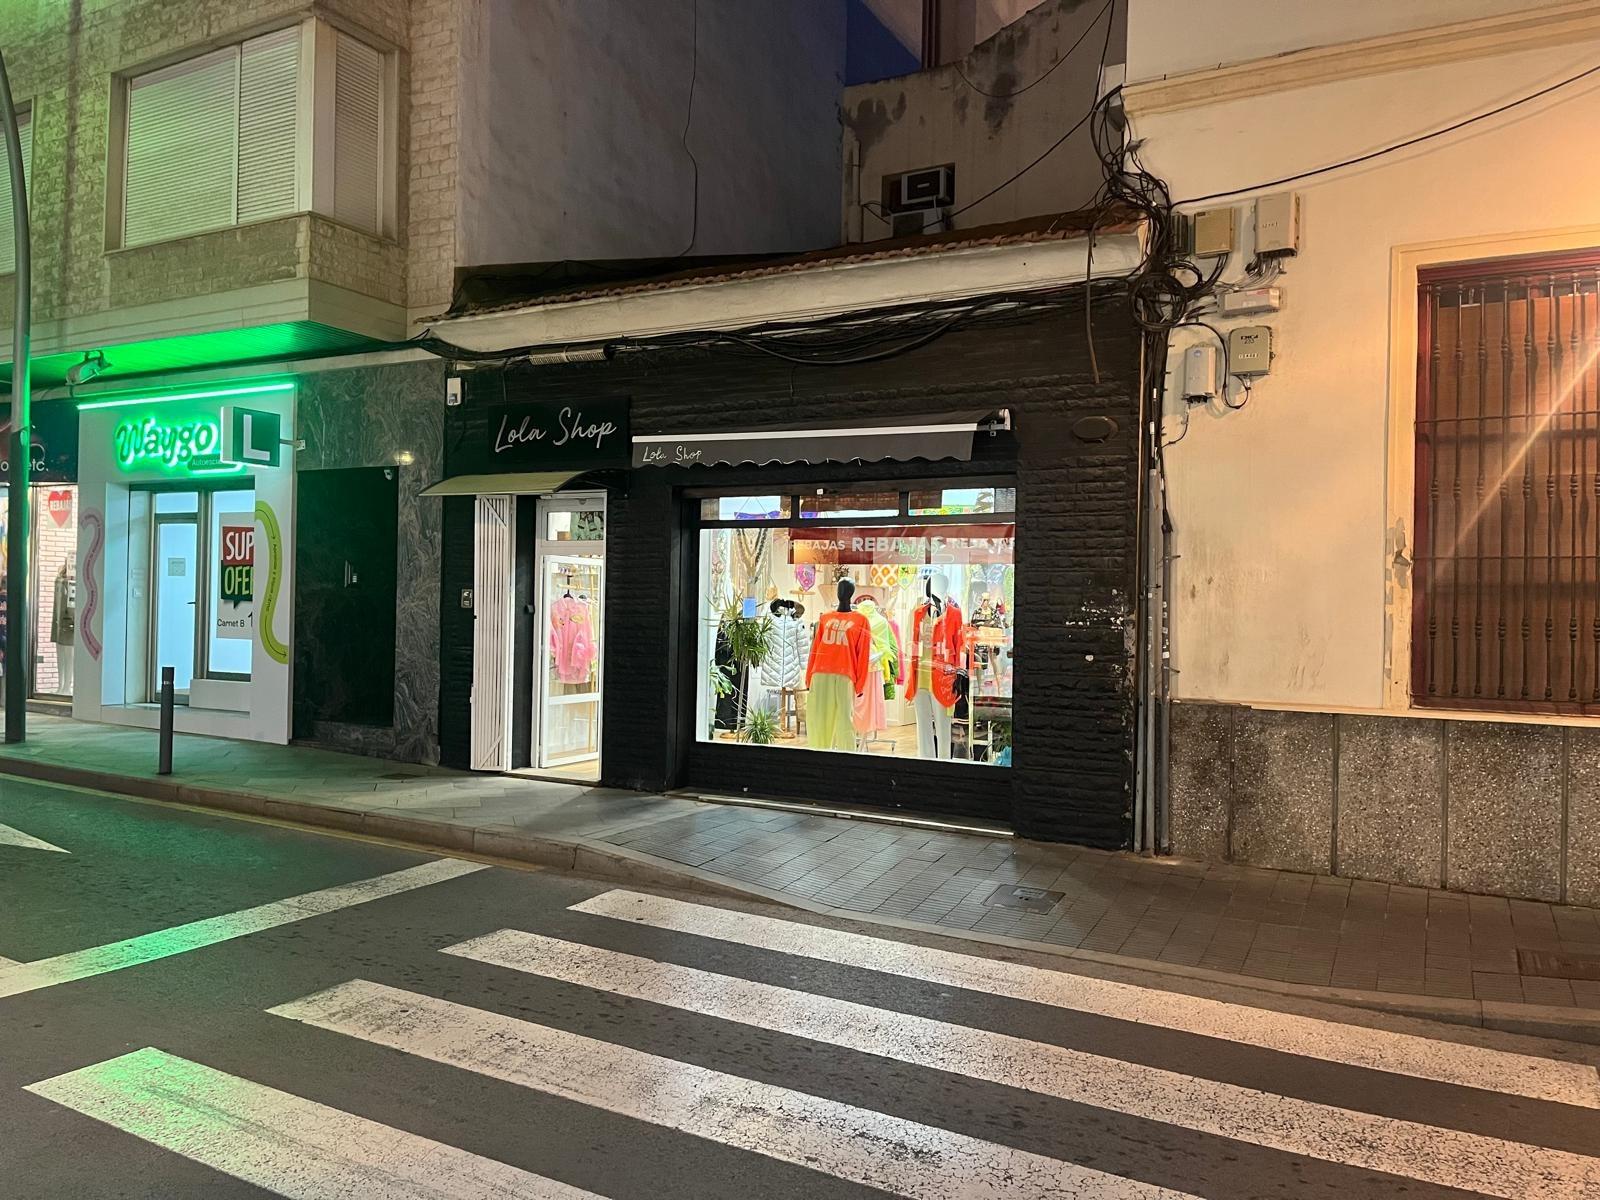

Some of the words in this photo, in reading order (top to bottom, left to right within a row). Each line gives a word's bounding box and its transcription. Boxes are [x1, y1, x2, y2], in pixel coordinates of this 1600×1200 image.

[115, 416, 218, 466] Waygo
[243, 413, 271, 462] L
[494, 414, 547, 453] Lola
[553, 407, 617, 449] Shop
[642, 446, 667, 463] Lola
[674, 445, 702, 462] Shop
[851, 536, 945, 552] REBAJAS
[217, 618, 239, 627] Carnet
